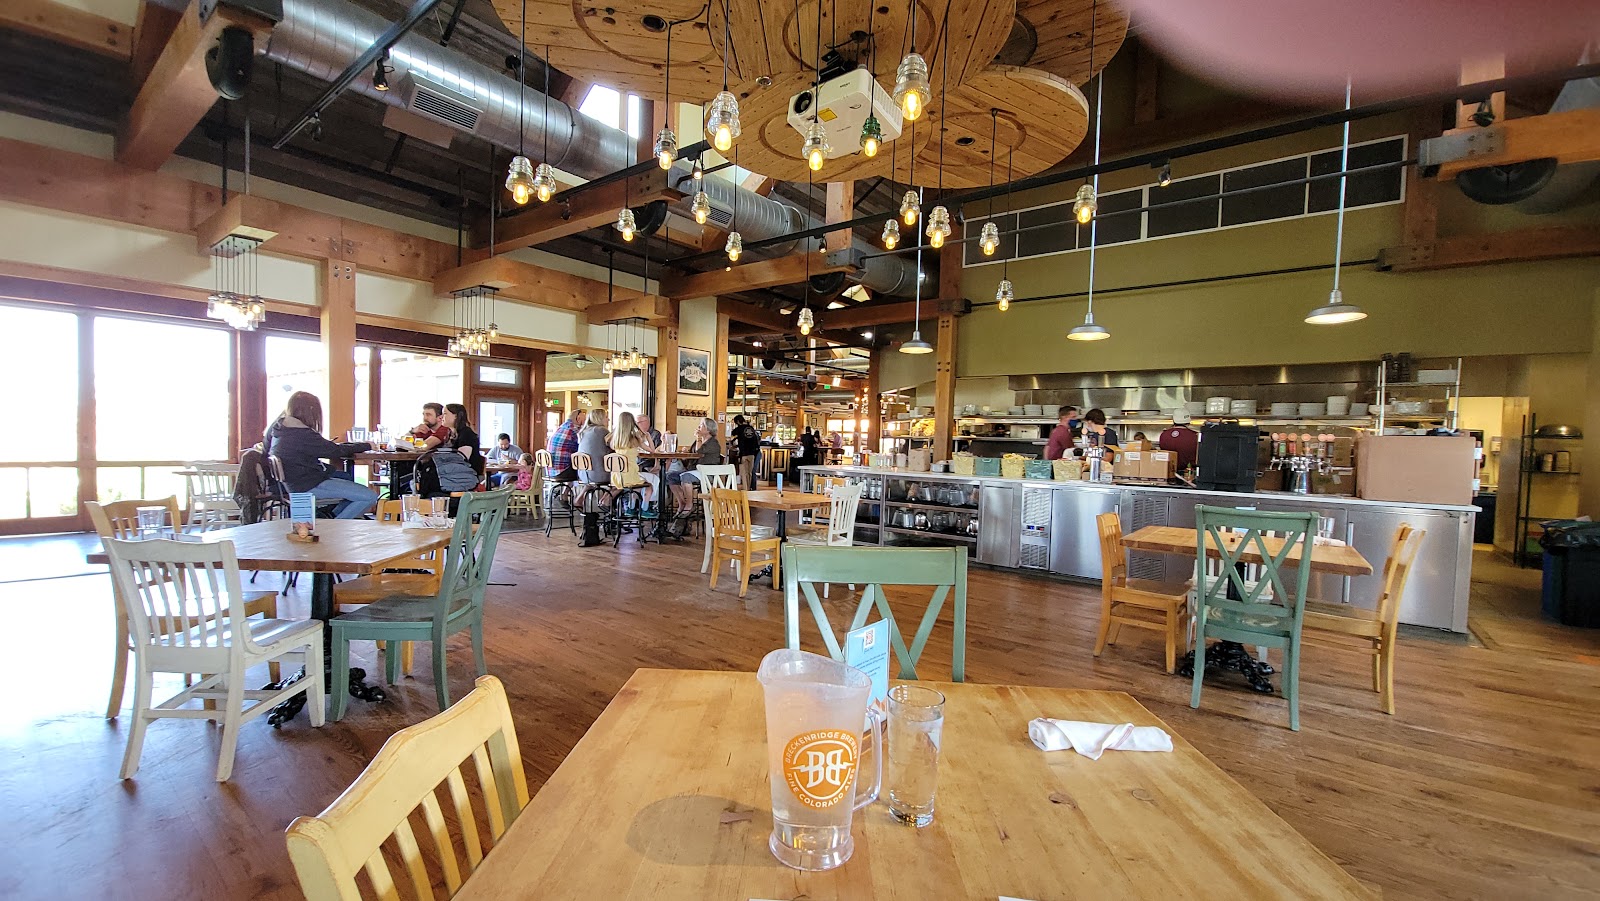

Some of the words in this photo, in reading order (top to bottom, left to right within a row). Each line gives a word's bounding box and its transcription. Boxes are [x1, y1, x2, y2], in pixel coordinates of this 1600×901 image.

[785, 731, 839, 763] BRECKENRIDGE
[786, 773, 799, 792] FINE
[799, 793, 844, 807] COLORADO
